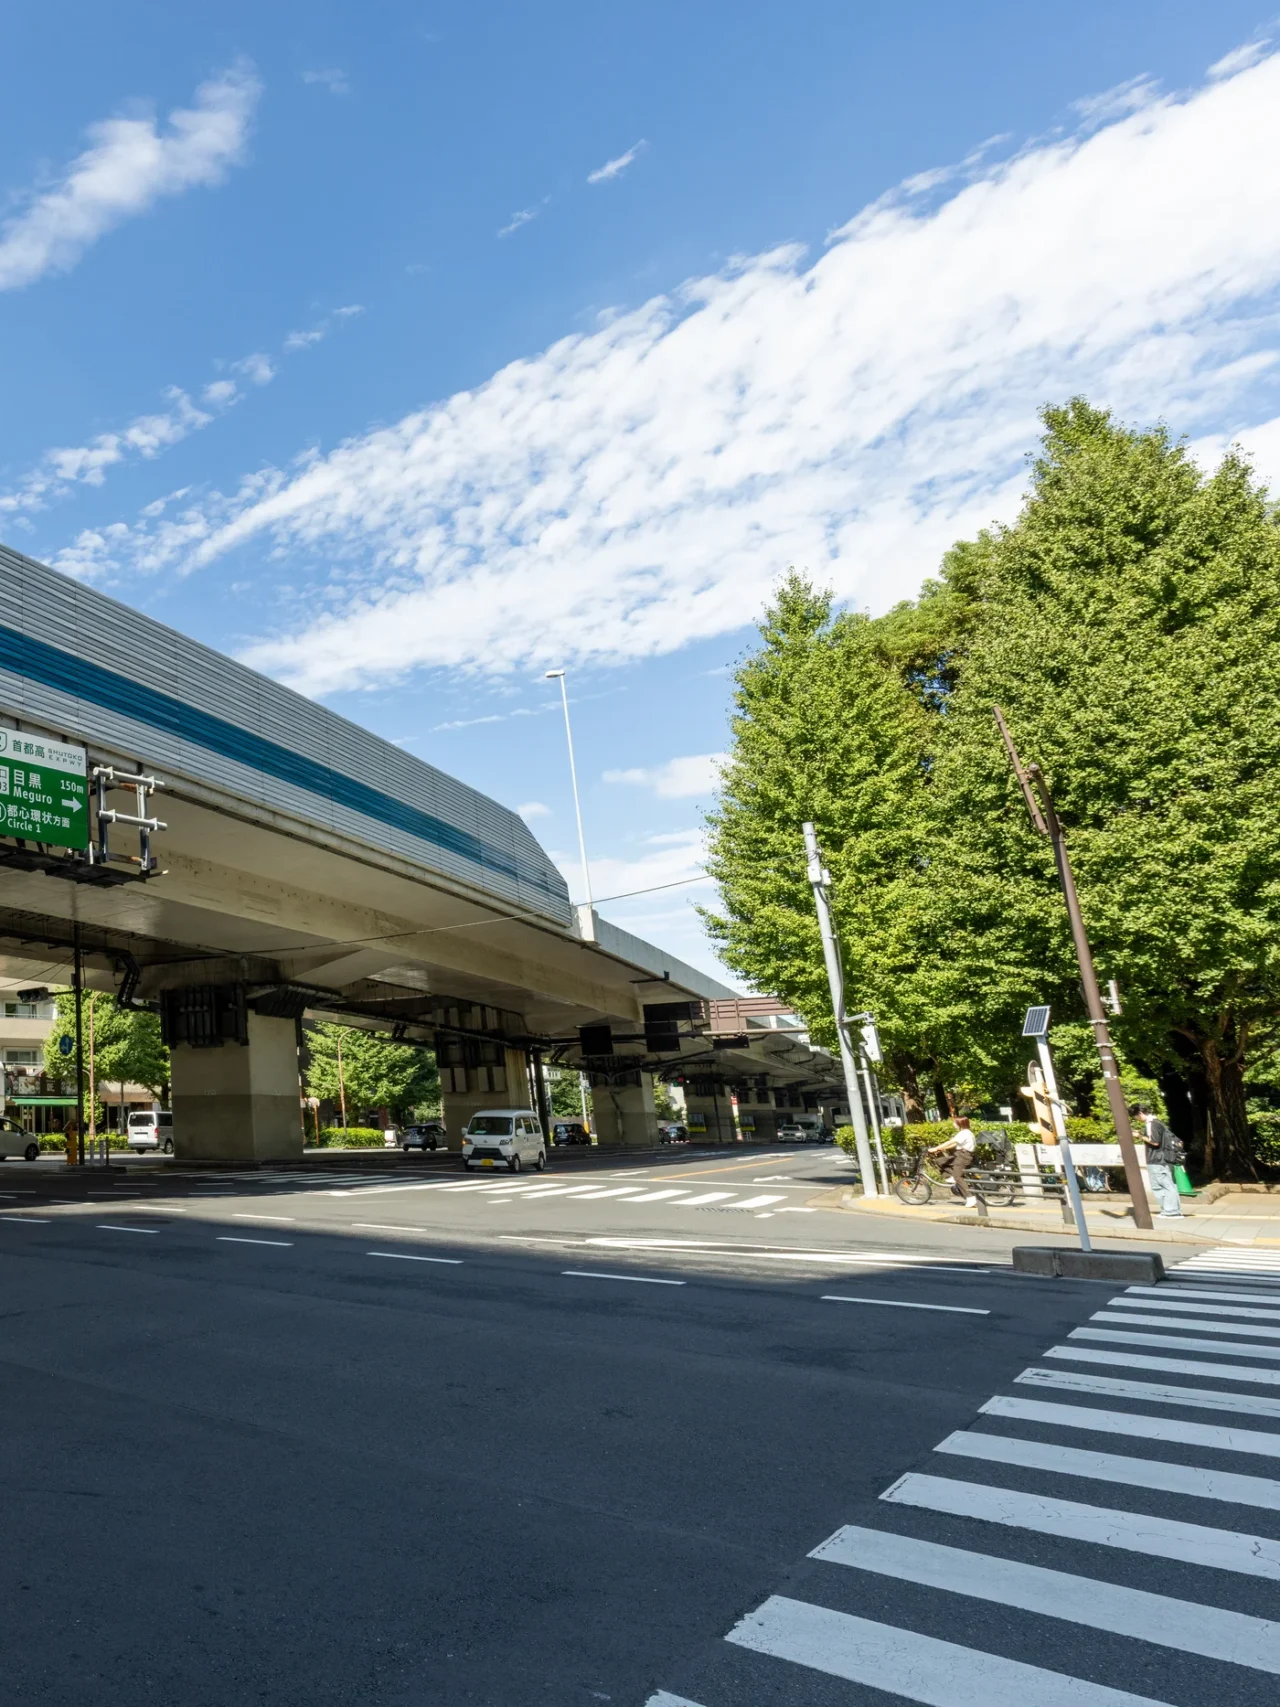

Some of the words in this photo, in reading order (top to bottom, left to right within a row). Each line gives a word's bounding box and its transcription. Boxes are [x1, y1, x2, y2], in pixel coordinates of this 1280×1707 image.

[12, 740, 45, 758] 首都高
[48, 748, 82, 761] SHUTOKO
[48, 755, 82, 767] EXPWY
[13, 769, 42, 789] 目黒
[60, 780, 84, 794] 150m
[13, 786, 52, 804] Meguro
[7, 804, 70, 828] 都心環状方面
[7, 818, 33, 831] Circle
[35, 824, 41, 833] 1
